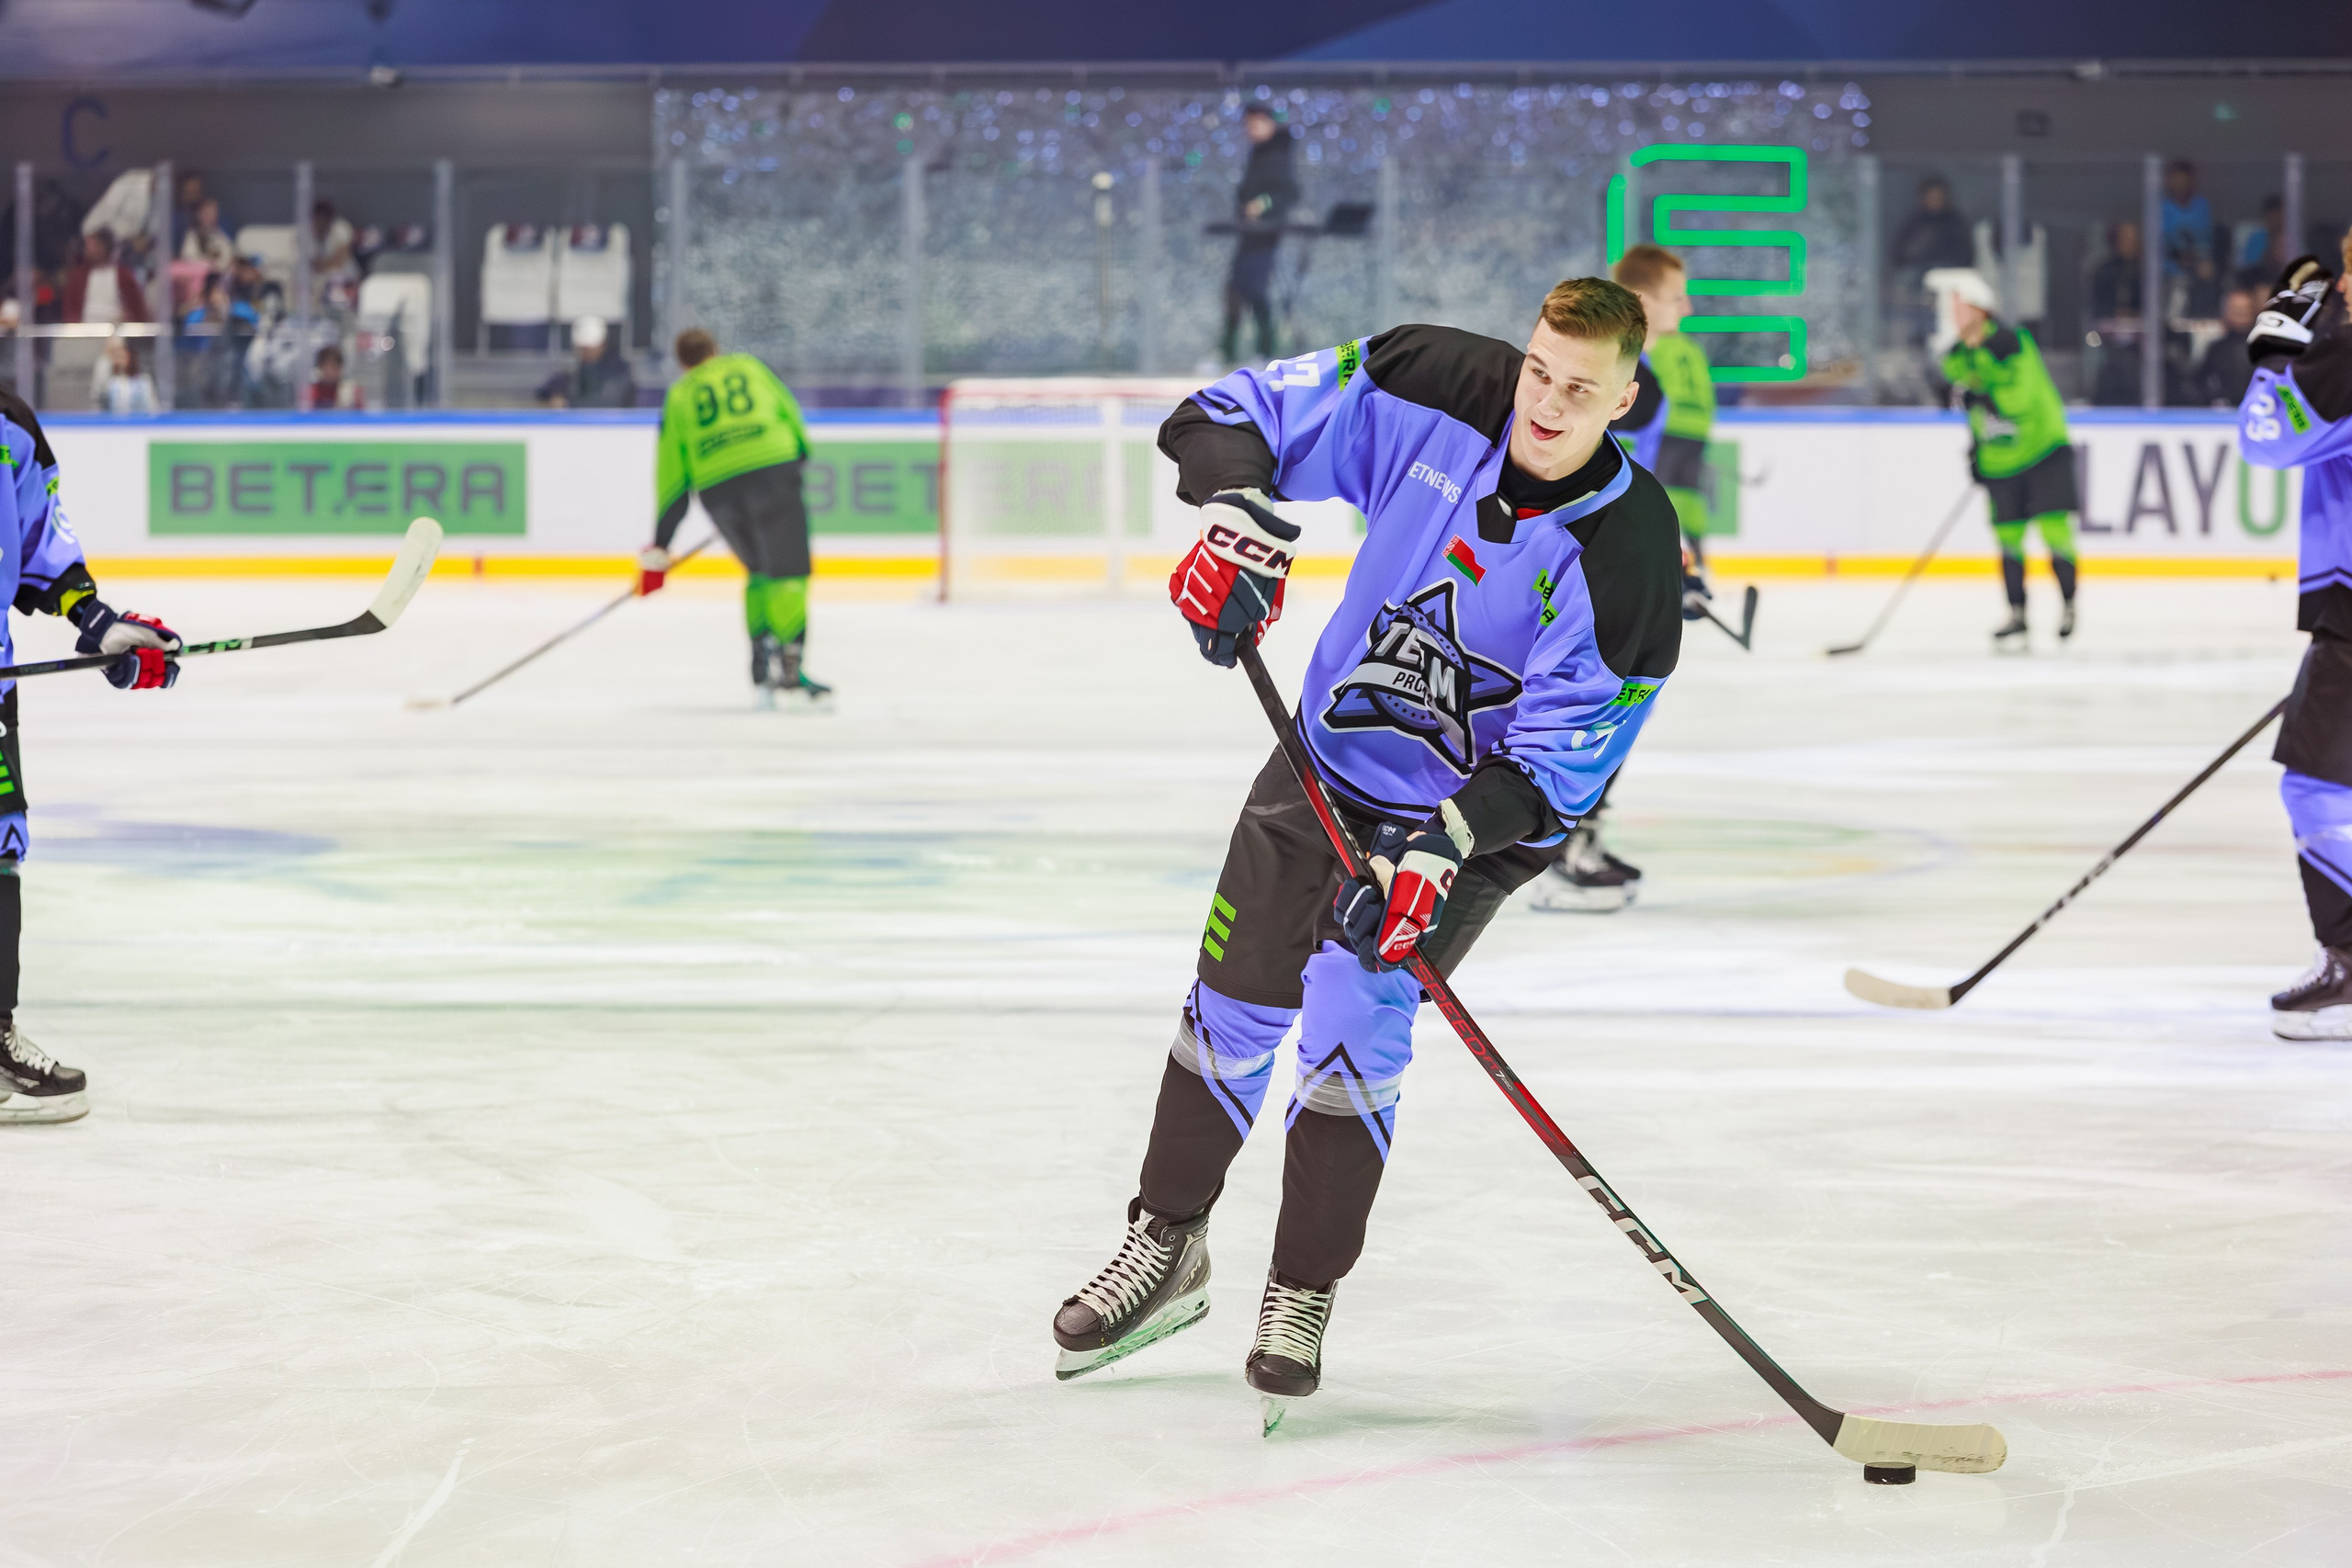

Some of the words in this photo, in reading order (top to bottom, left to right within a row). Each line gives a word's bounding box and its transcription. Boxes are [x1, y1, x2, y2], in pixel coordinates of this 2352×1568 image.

[1206, 524, 1295, 577] CCM
[1374, 621, 1457, 713] TEM
[1577, 1175, 1710, 1305] CCM
